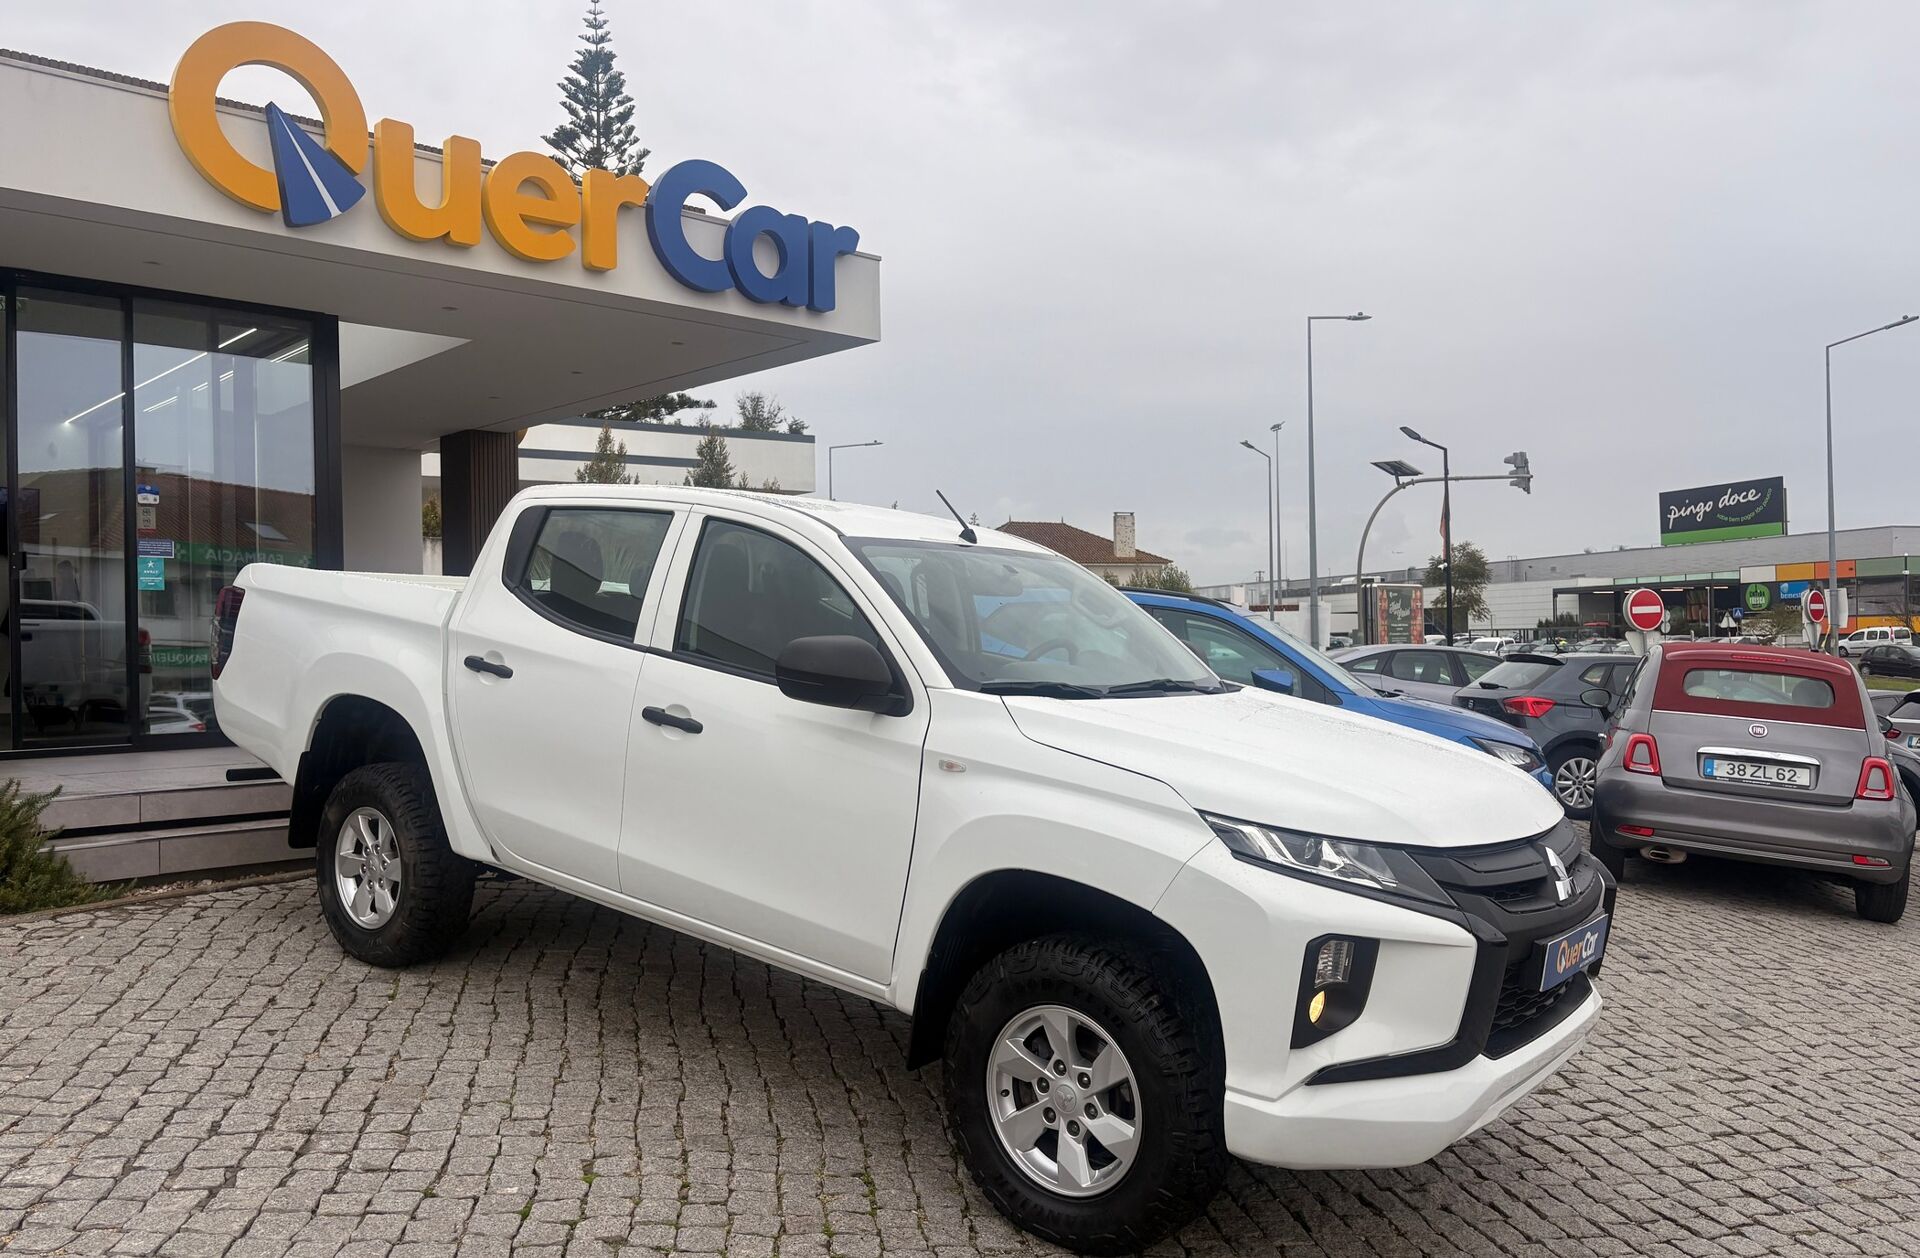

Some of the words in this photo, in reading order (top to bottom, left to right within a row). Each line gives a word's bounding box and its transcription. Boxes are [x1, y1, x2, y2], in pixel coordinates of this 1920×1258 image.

[169, 21, 859, 312] QuerCar
[1667, 499, 1713, 529] pingo
[1719, 488, 1761, 509] doce
[1726, 763, 1746, 776] 38
[1750, 765, 1772, 780] ZL
[1776, 768, 1797, 782] 62
[1557, 931, 1599, 974] QuerCar
